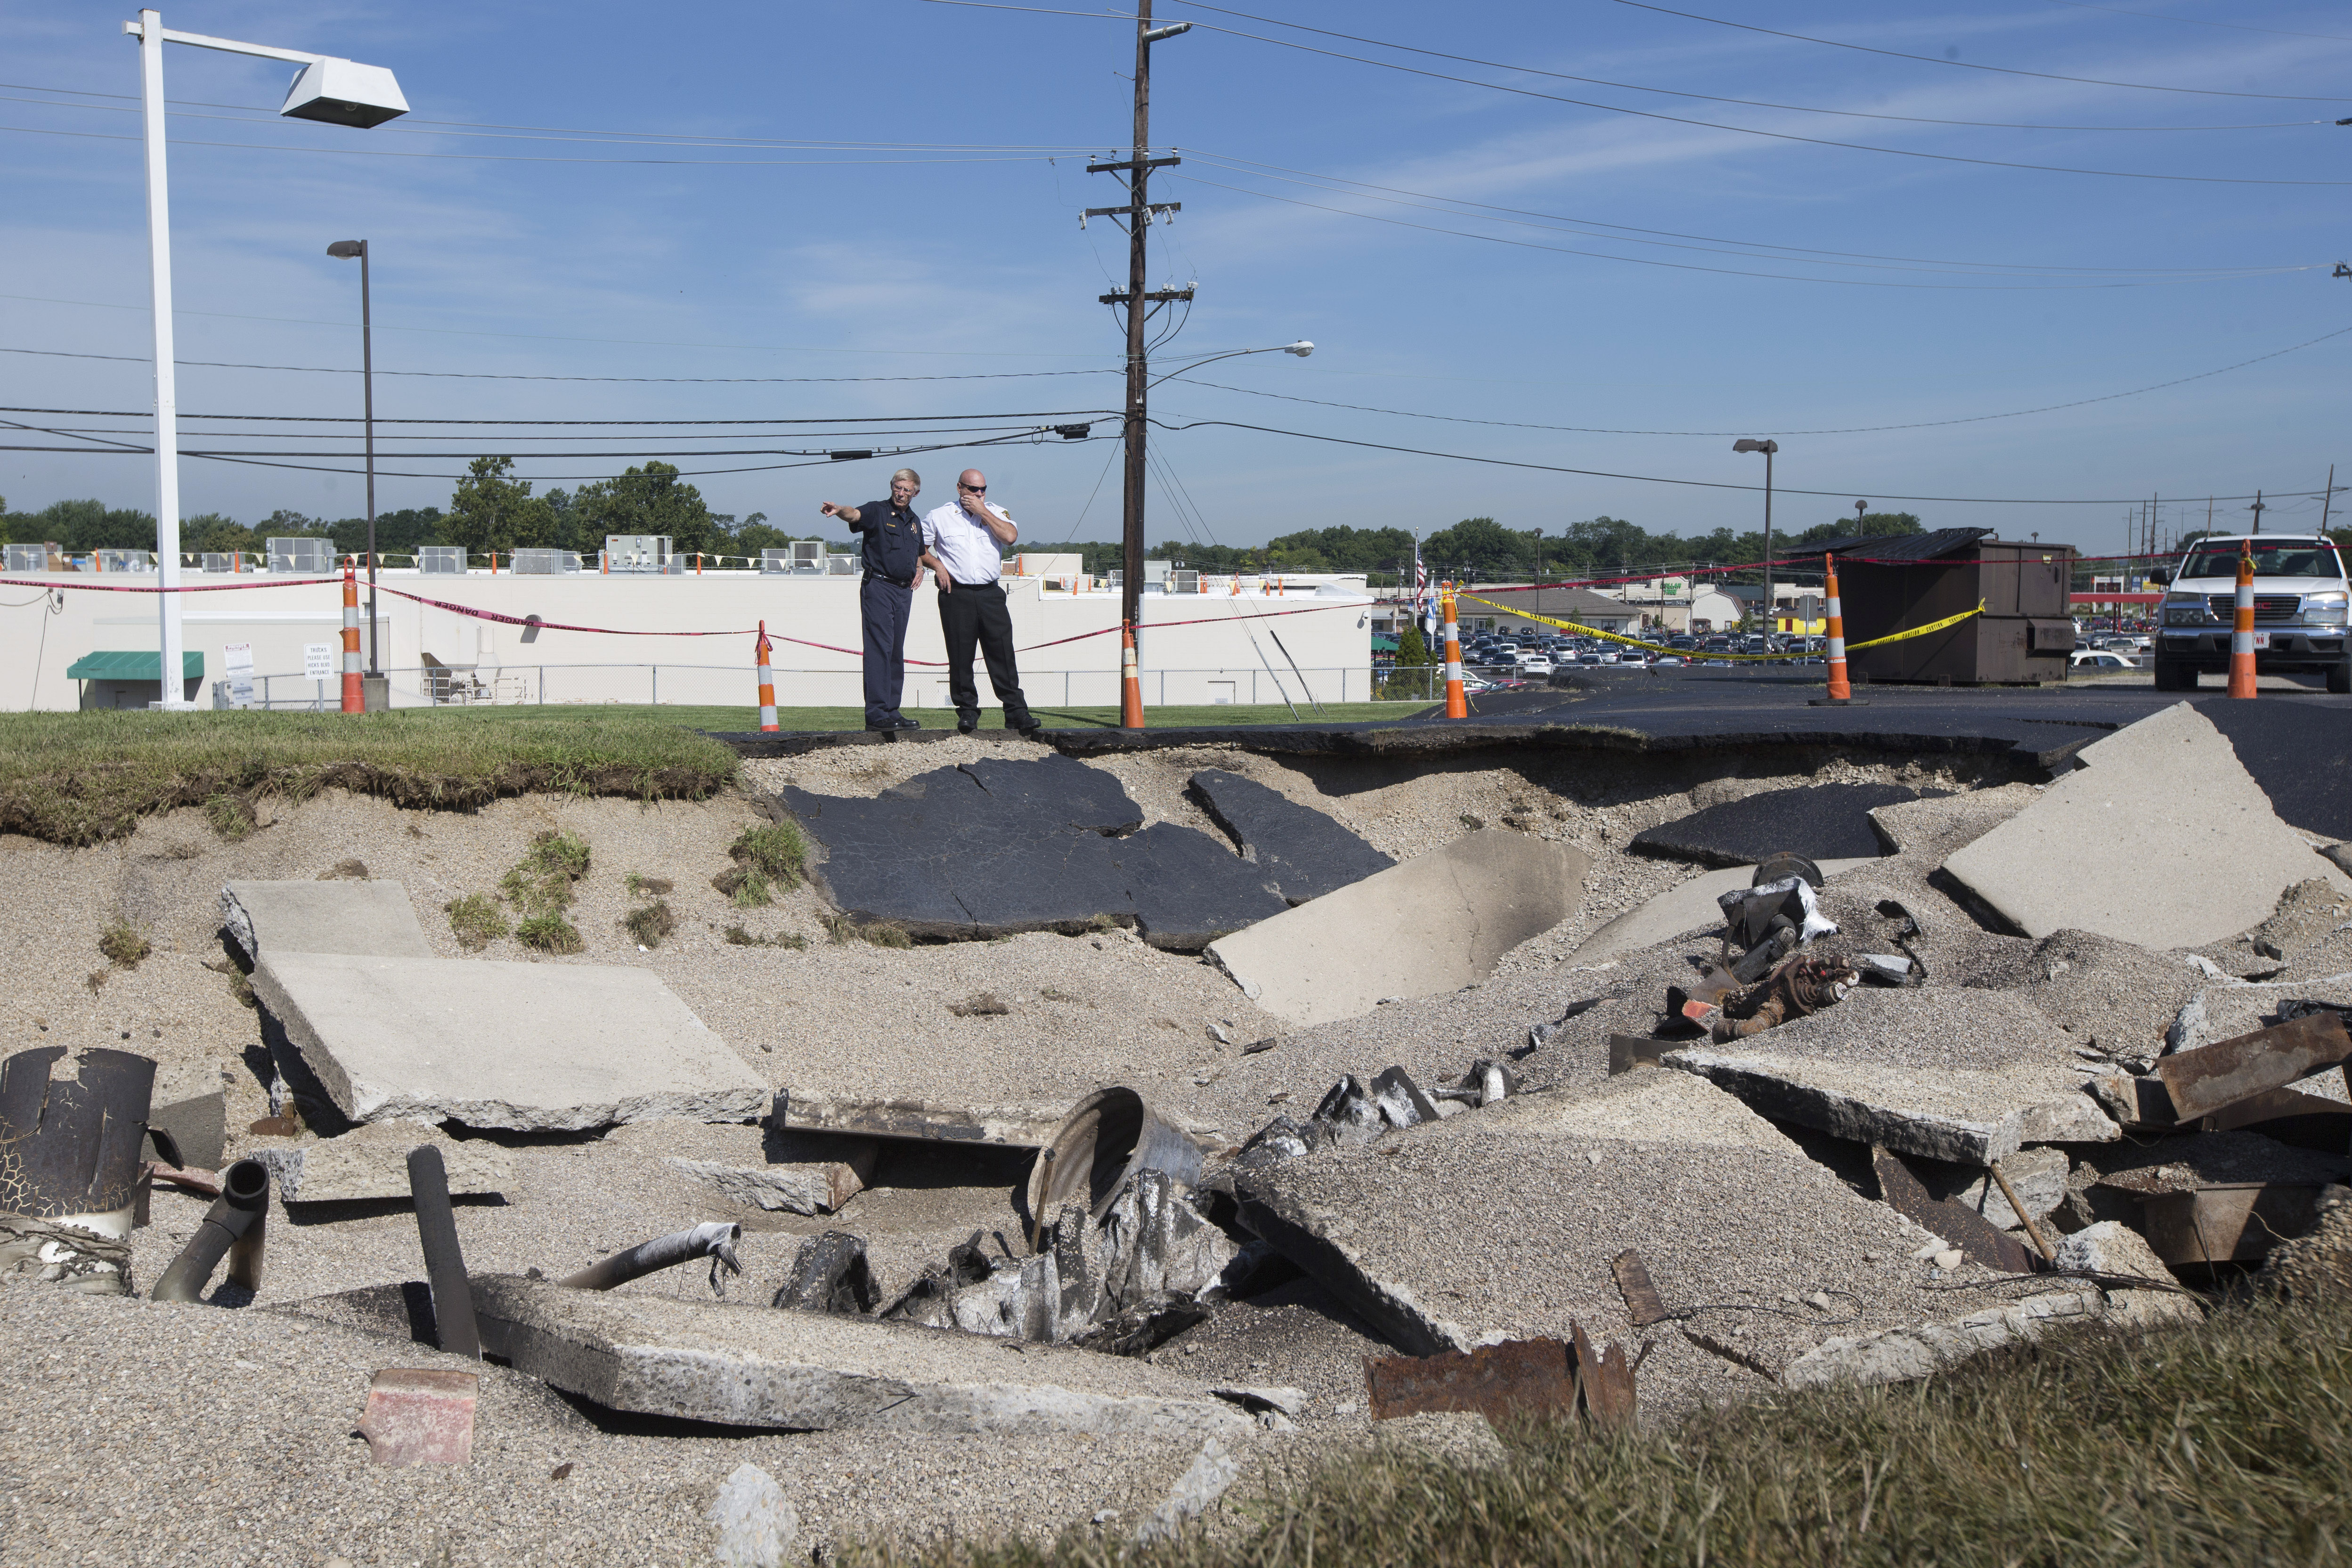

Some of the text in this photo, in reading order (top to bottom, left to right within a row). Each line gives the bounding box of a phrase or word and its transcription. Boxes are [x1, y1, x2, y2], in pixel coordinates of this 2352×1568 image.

[434, 601, 479, 617] DANGER
[490, 614, 534, 626] DANGER
[1530, 613, 1556, 625] CAUTION
[1568, 624, 1594, 636] CAUTION
[1603, 634, 1630, 644] CAUTION
[1876, 636, 1895, 645] CAUTION
[1902, 629, 1920, 639] CAUTION
[1926, 622, 1944, 632] CAUTION
[1949, 614, 1965, 623] CAUTION
[2254, 636, 2264, 644] NN
